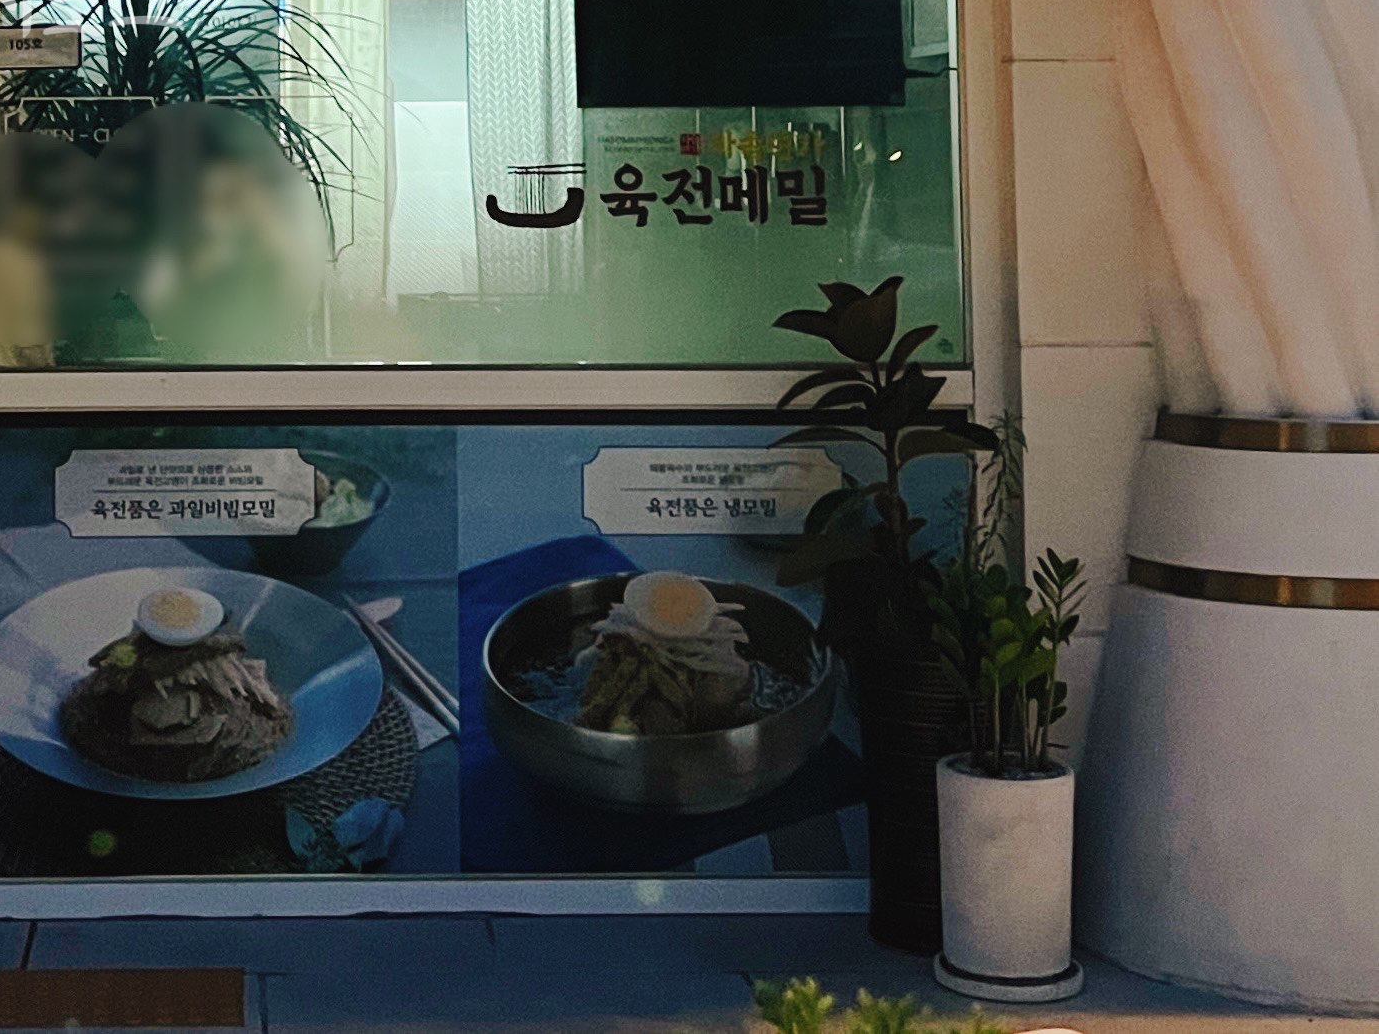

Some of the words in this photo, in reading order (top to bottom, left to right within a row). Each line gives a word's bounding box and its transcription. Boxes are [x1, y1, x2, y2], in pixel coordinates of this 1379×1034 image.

[599, 163, 828, 228] 육전메밀
[91, 499, 163, 519] 육전품은
[168, 499, 276, 519] 과일비빔모밀
[646, 497, 718, 518] 육전품은
[724, 497, 777, 518] 냉모밀
